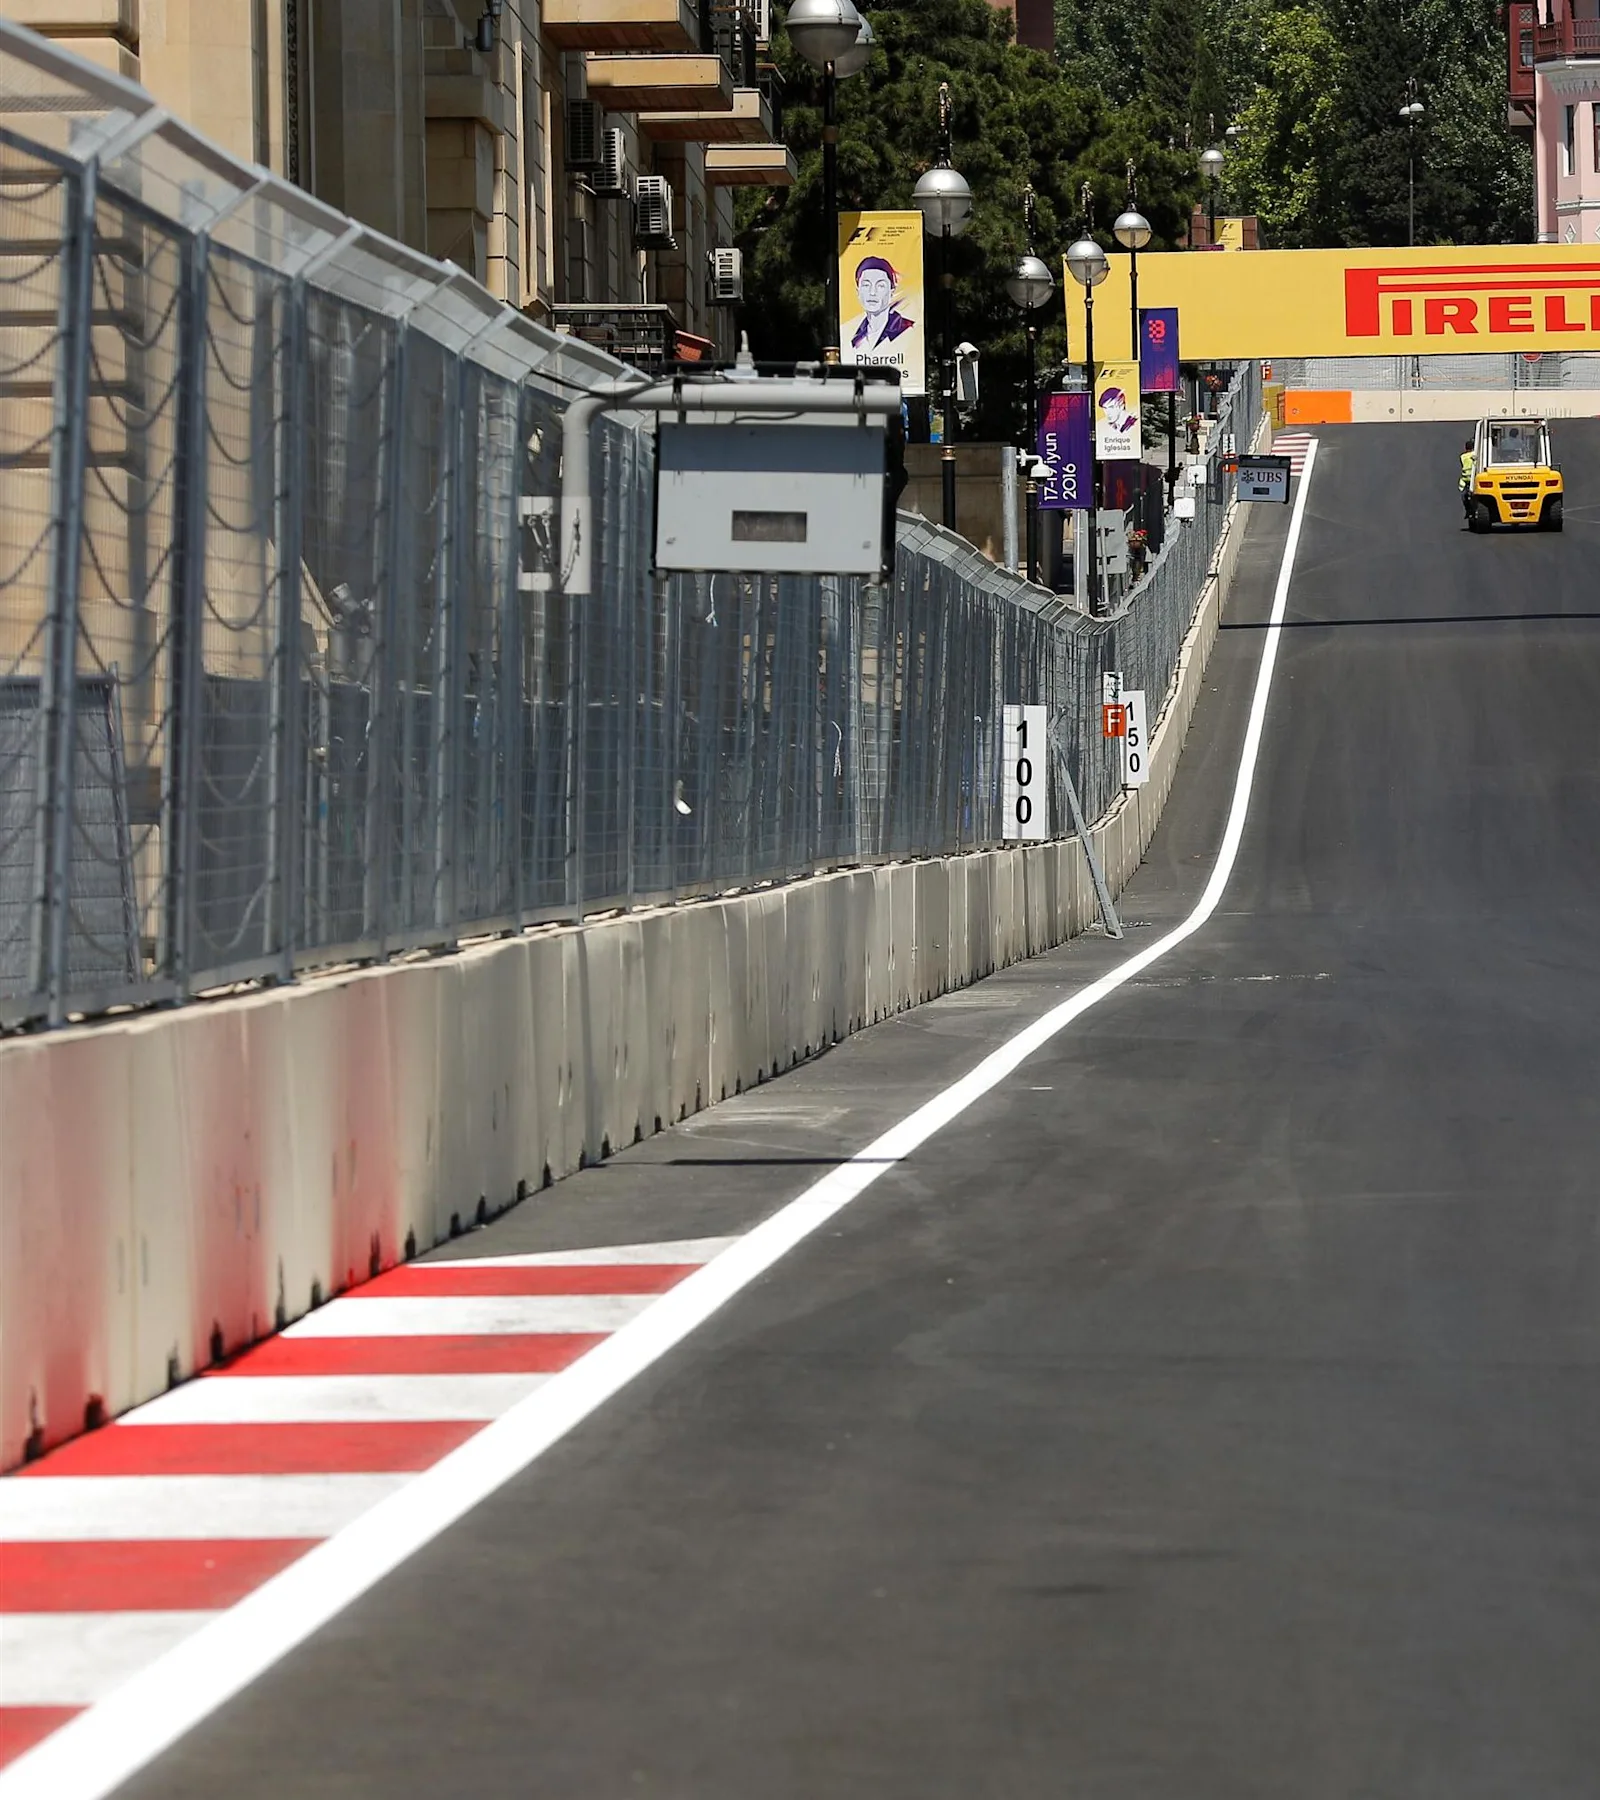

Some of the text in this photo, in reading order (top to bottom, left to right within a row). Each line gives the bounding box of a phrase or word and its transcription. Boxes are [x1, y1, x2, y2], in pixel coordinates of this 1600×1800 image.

[856, 353, 904, 366] Pharrell
[1044, 433, 1061, 463] iyun
[1104, 437, 1131, 445] Enrique
[1062, 463, 1077, 500] 2016
[1257, 472, 1282, 483] UBS
[1107, 708, 1122, 733] F
[1125, 701, 1141, 773] 150
[1015, 720, 1033, 824] 100
